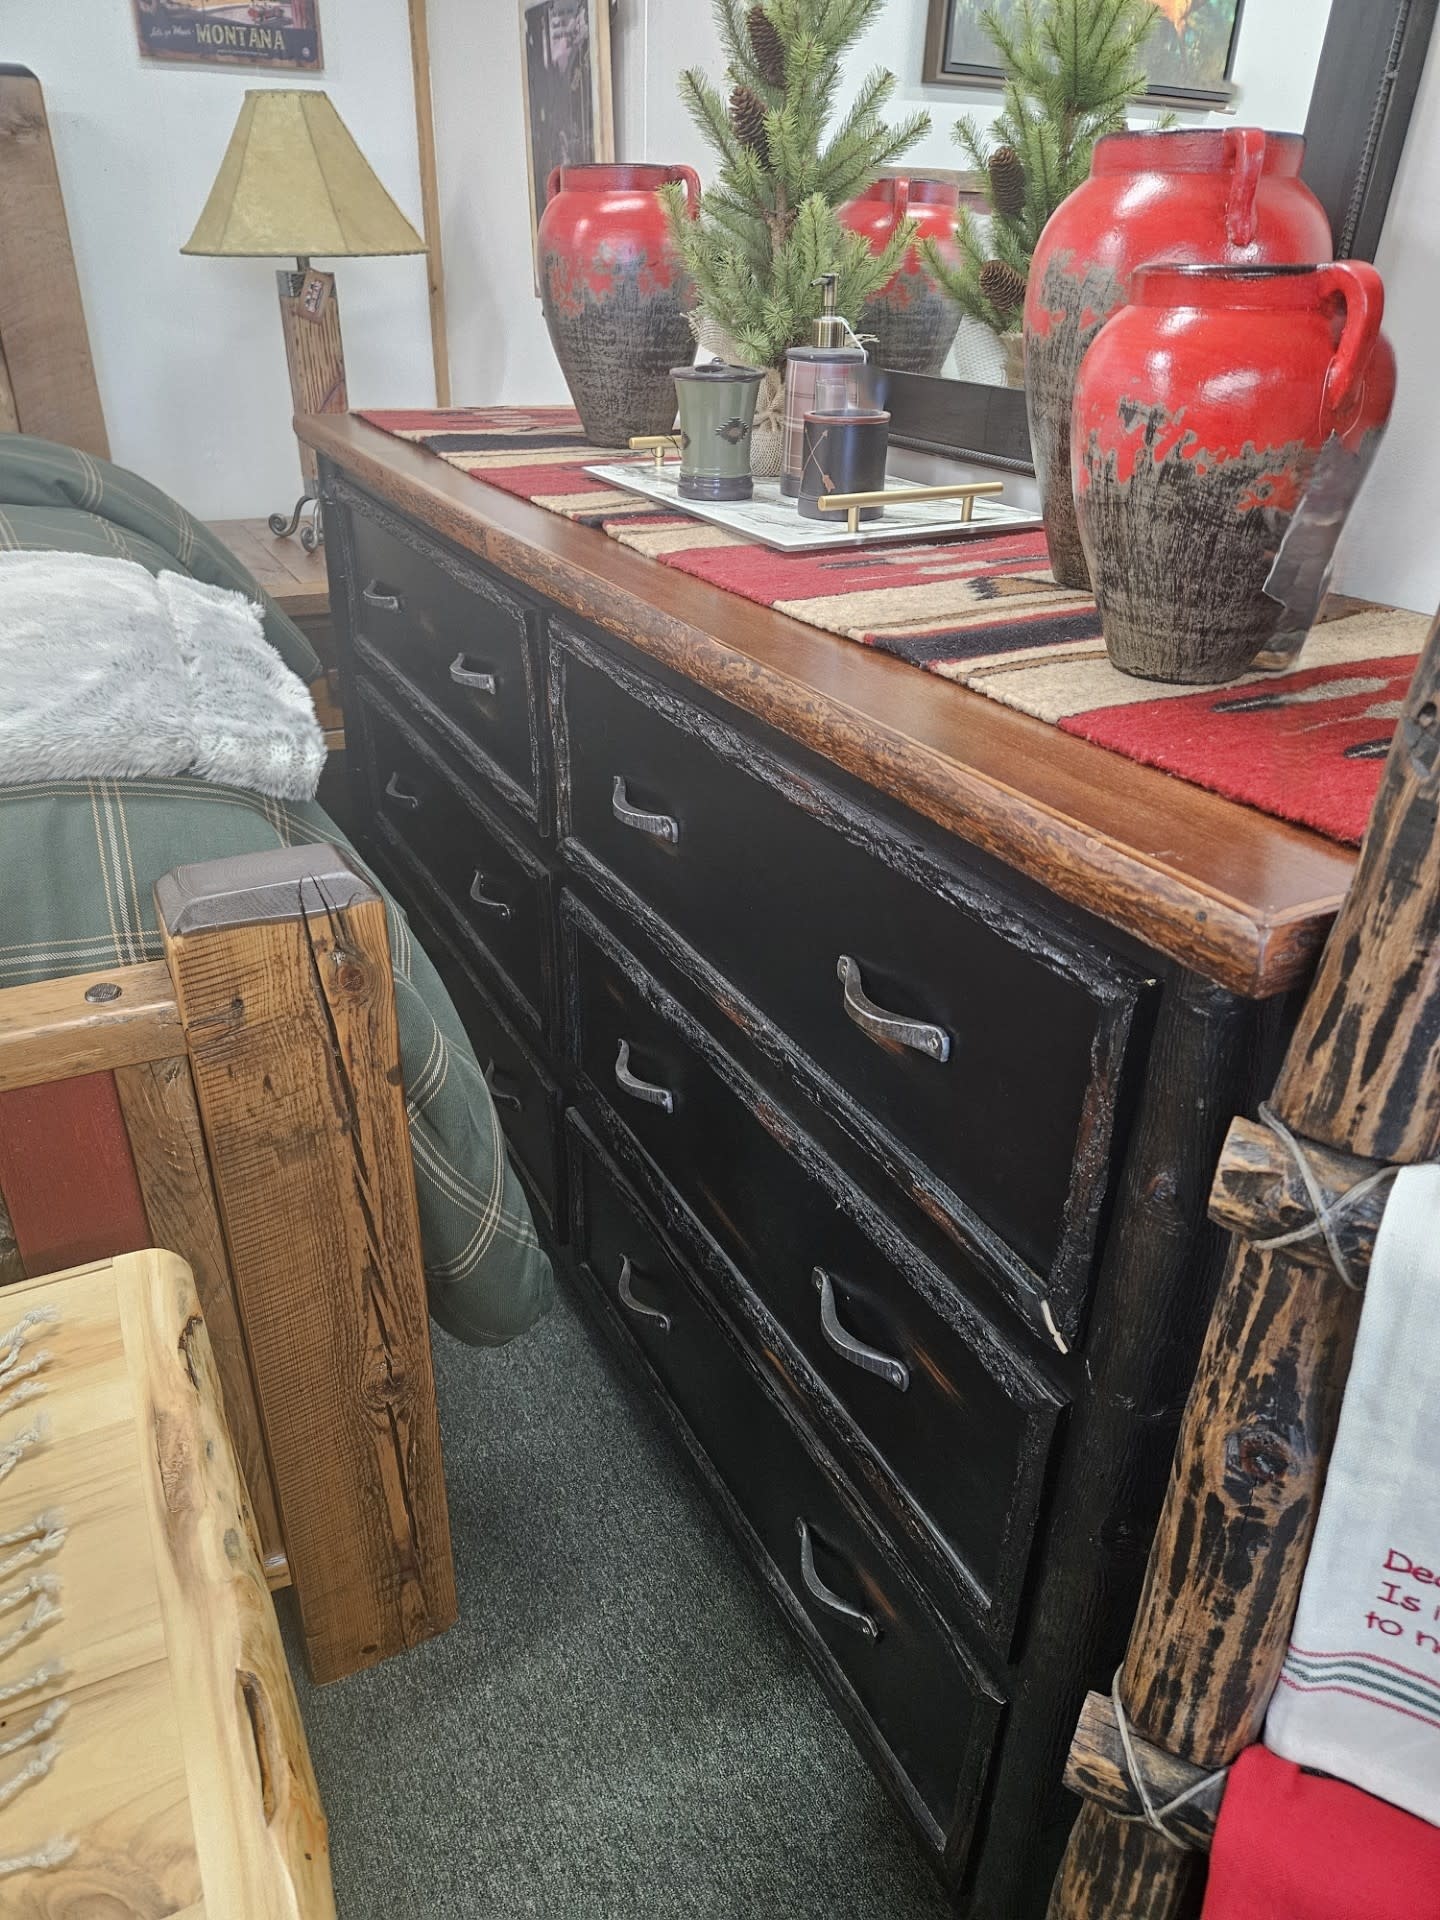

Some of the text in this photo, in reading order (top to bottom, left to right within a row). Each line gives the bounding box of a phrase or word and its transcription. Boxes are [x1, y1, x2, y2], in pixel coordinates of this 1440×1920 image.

[195, 23, 285, 50] MONTANA
[1376, 1581, 1421, 1612] Is
[1365, 1611, 1404, 1636] to
